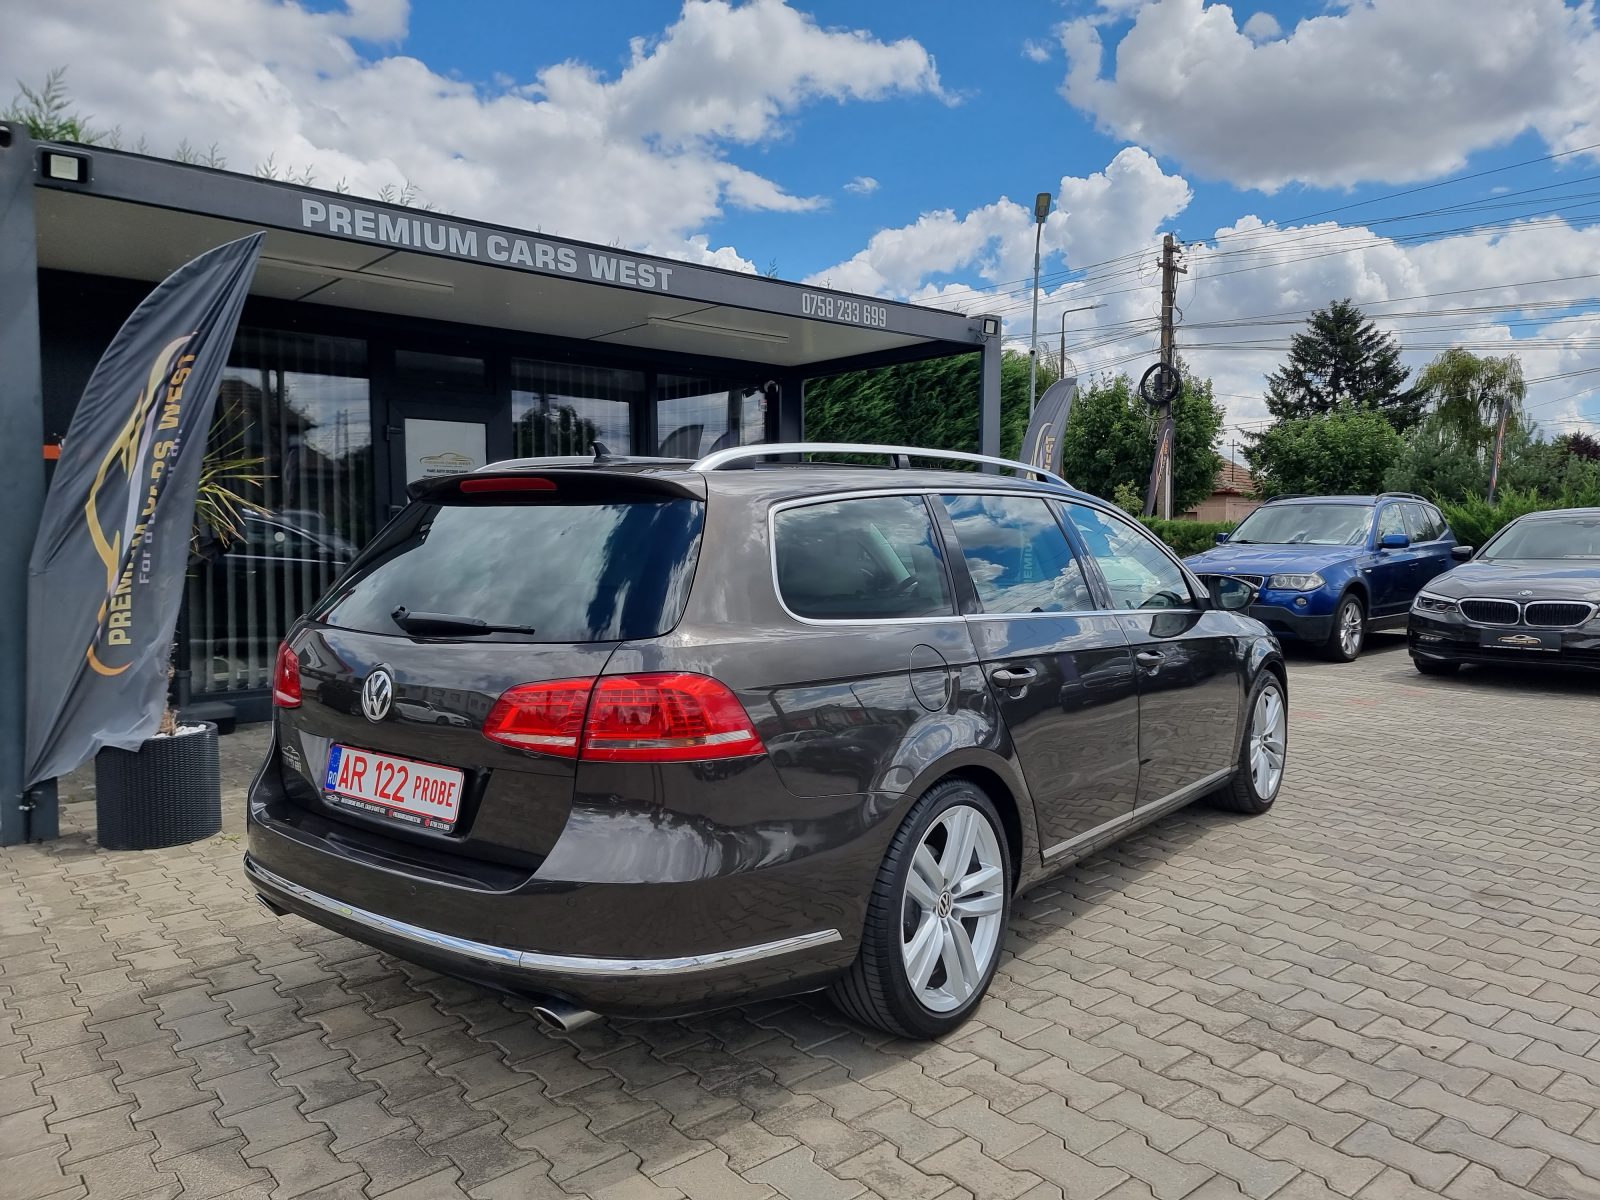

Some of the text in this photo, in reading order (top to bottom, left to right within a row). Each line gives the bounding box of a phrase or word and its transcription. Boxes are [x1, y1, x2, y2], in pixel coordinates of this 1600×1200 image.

[301, 199, 673, 291] PREMIUM CARS WEST
[802, 293, 887, 327] 0758 233 699
[157, 354, 196, 431] WEST
[139, 551, 151, 584] For
[1023, 540, 1033, 583] EMIU
[327, 770, 338, 785] RO
[338, 753, 368, 793] AR
[374, 760, 409, 803] 122
[412, 775, 456, 808] PROBE
